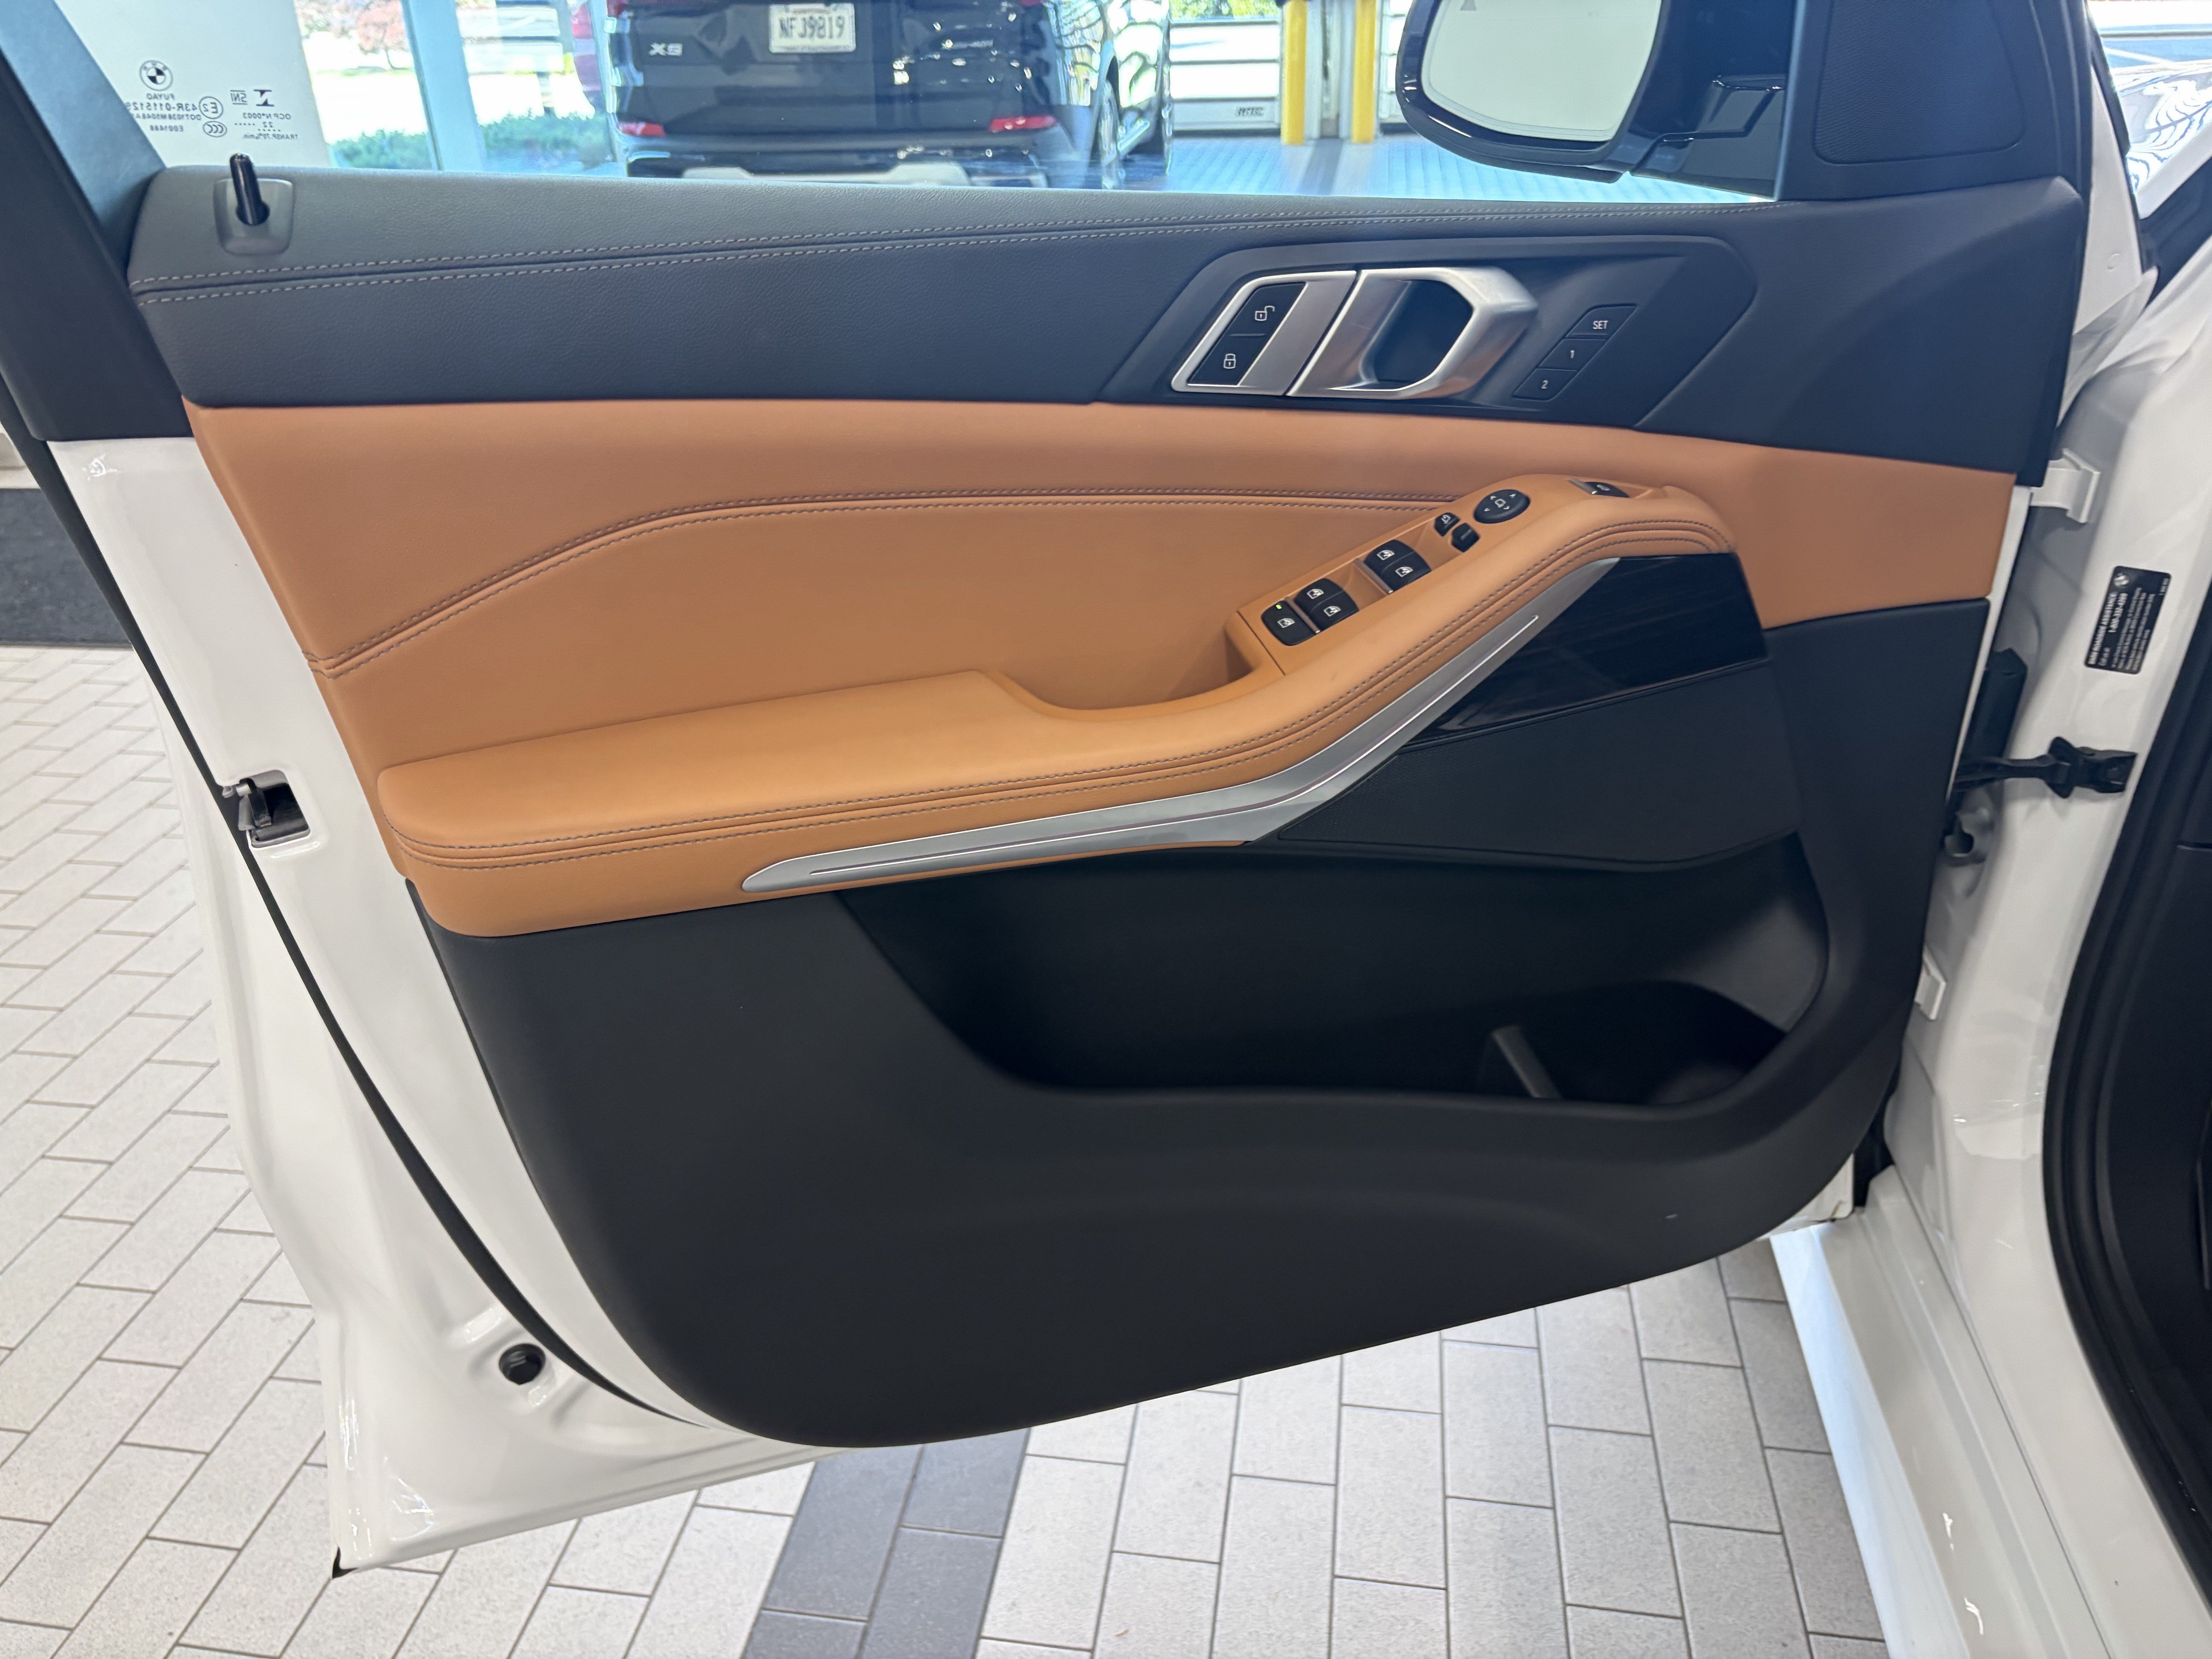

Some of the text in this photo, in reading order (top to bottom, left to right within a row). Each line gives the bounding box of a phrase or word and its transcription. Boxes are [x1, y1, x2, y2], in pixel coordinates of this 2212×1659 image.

[1593, 320, 1608, 329] SET
[1570, 350, 1575, 359] 1
[1541, 380, 1548, 389] 2
